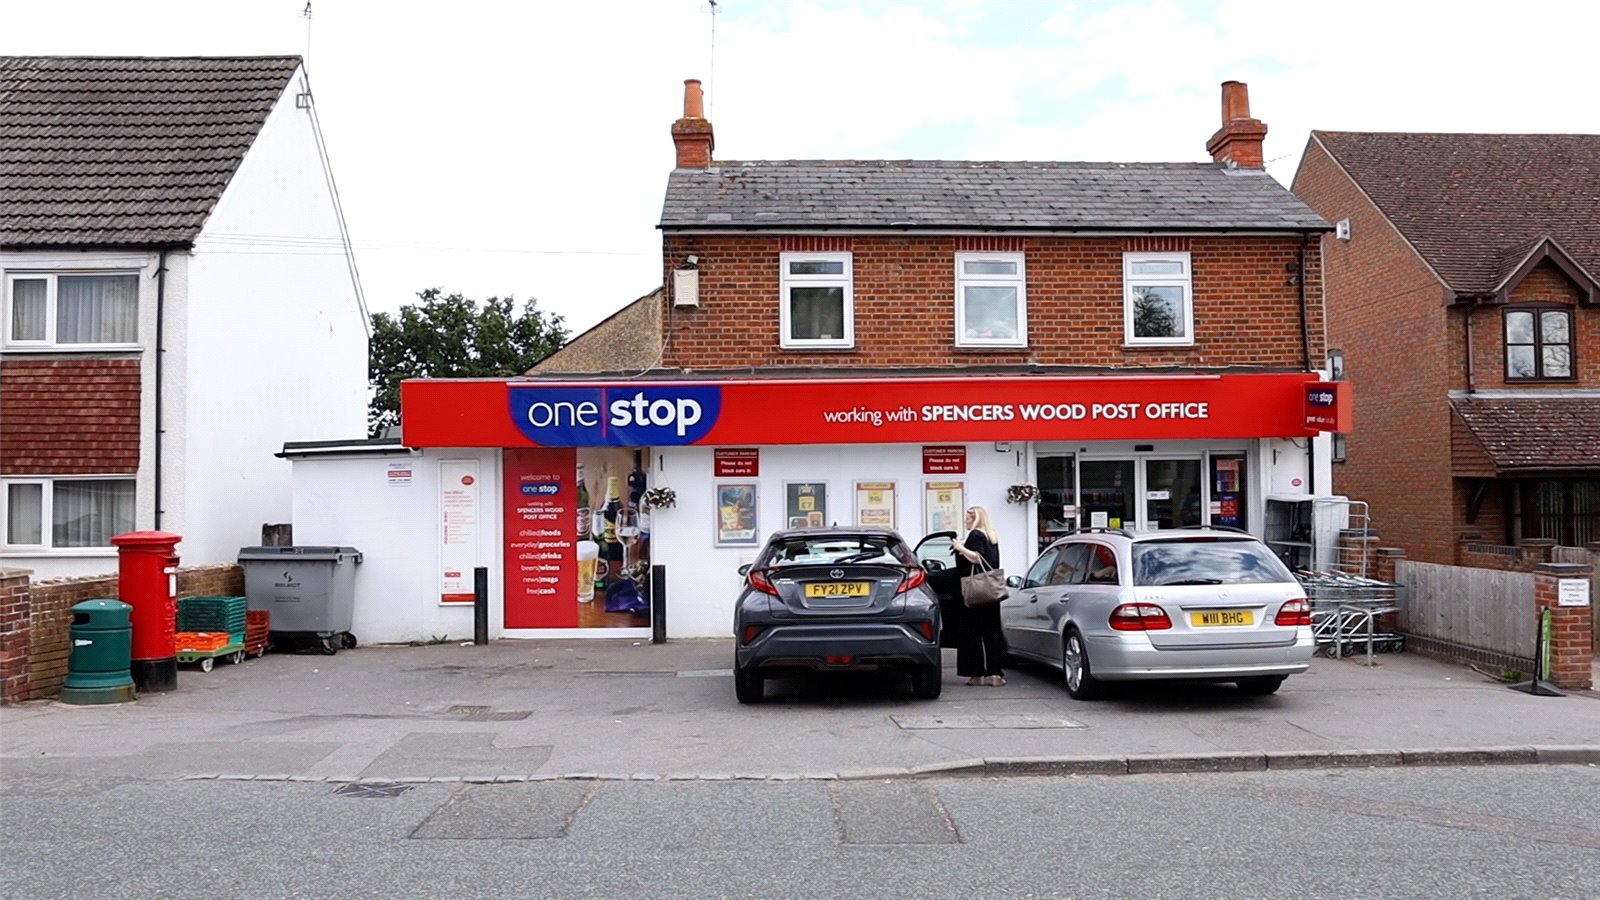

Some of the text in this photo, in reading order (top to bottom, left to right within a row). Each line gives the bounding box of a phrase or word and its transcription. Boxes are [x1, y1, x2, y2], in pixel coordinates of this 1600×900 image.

[1319, 391, 1333, 405] stop
[528, 391, 702, 436] one stop
[823, 402, 1209, 426] working with SPENCERS WOOD POST OFFICE
[520, 473, 551, 481] welcome
[538, 485, 558, 495] stop
[813, 583, 862, 595] FY21 ZPV
[1222, 612, 1244, 624] BHG
